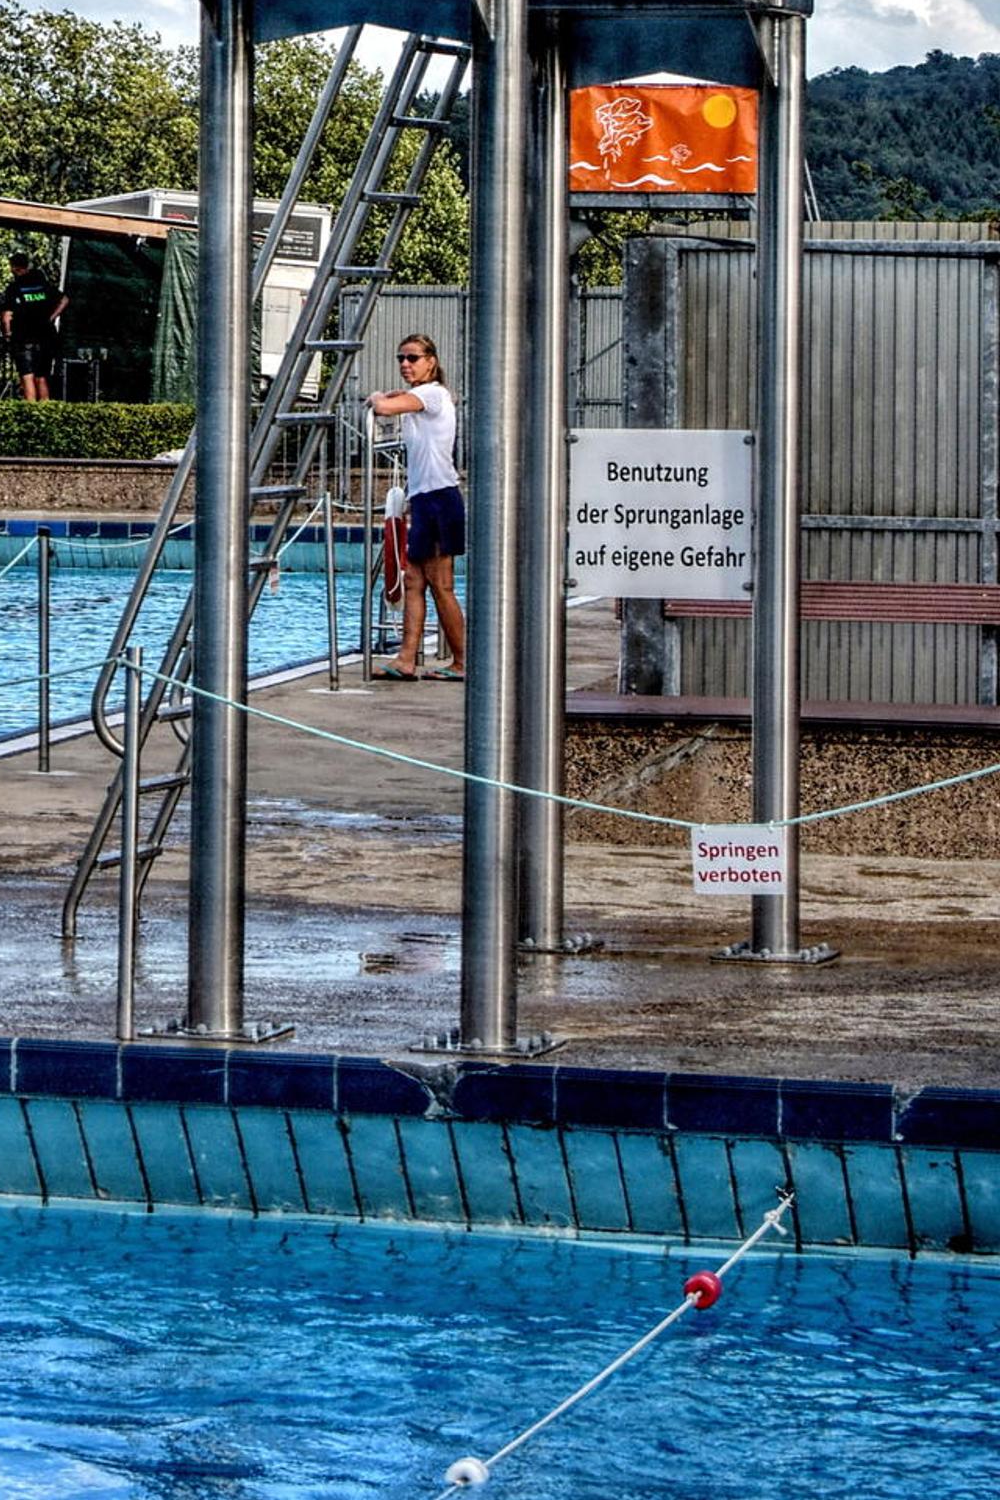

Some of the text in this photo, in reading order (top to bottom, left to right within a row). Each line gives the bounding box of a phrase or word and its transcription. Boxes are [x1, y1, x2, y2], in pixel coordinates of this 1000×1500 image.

[606, 461, 709, 488] Benutzung
[576, 502, 745, 531] der Sprunganlage
[575, 544, 747, 572] auf eigene Gefahr
[697, 841, 779, 862] Springen
[698, 866, 783, 883] verboten
